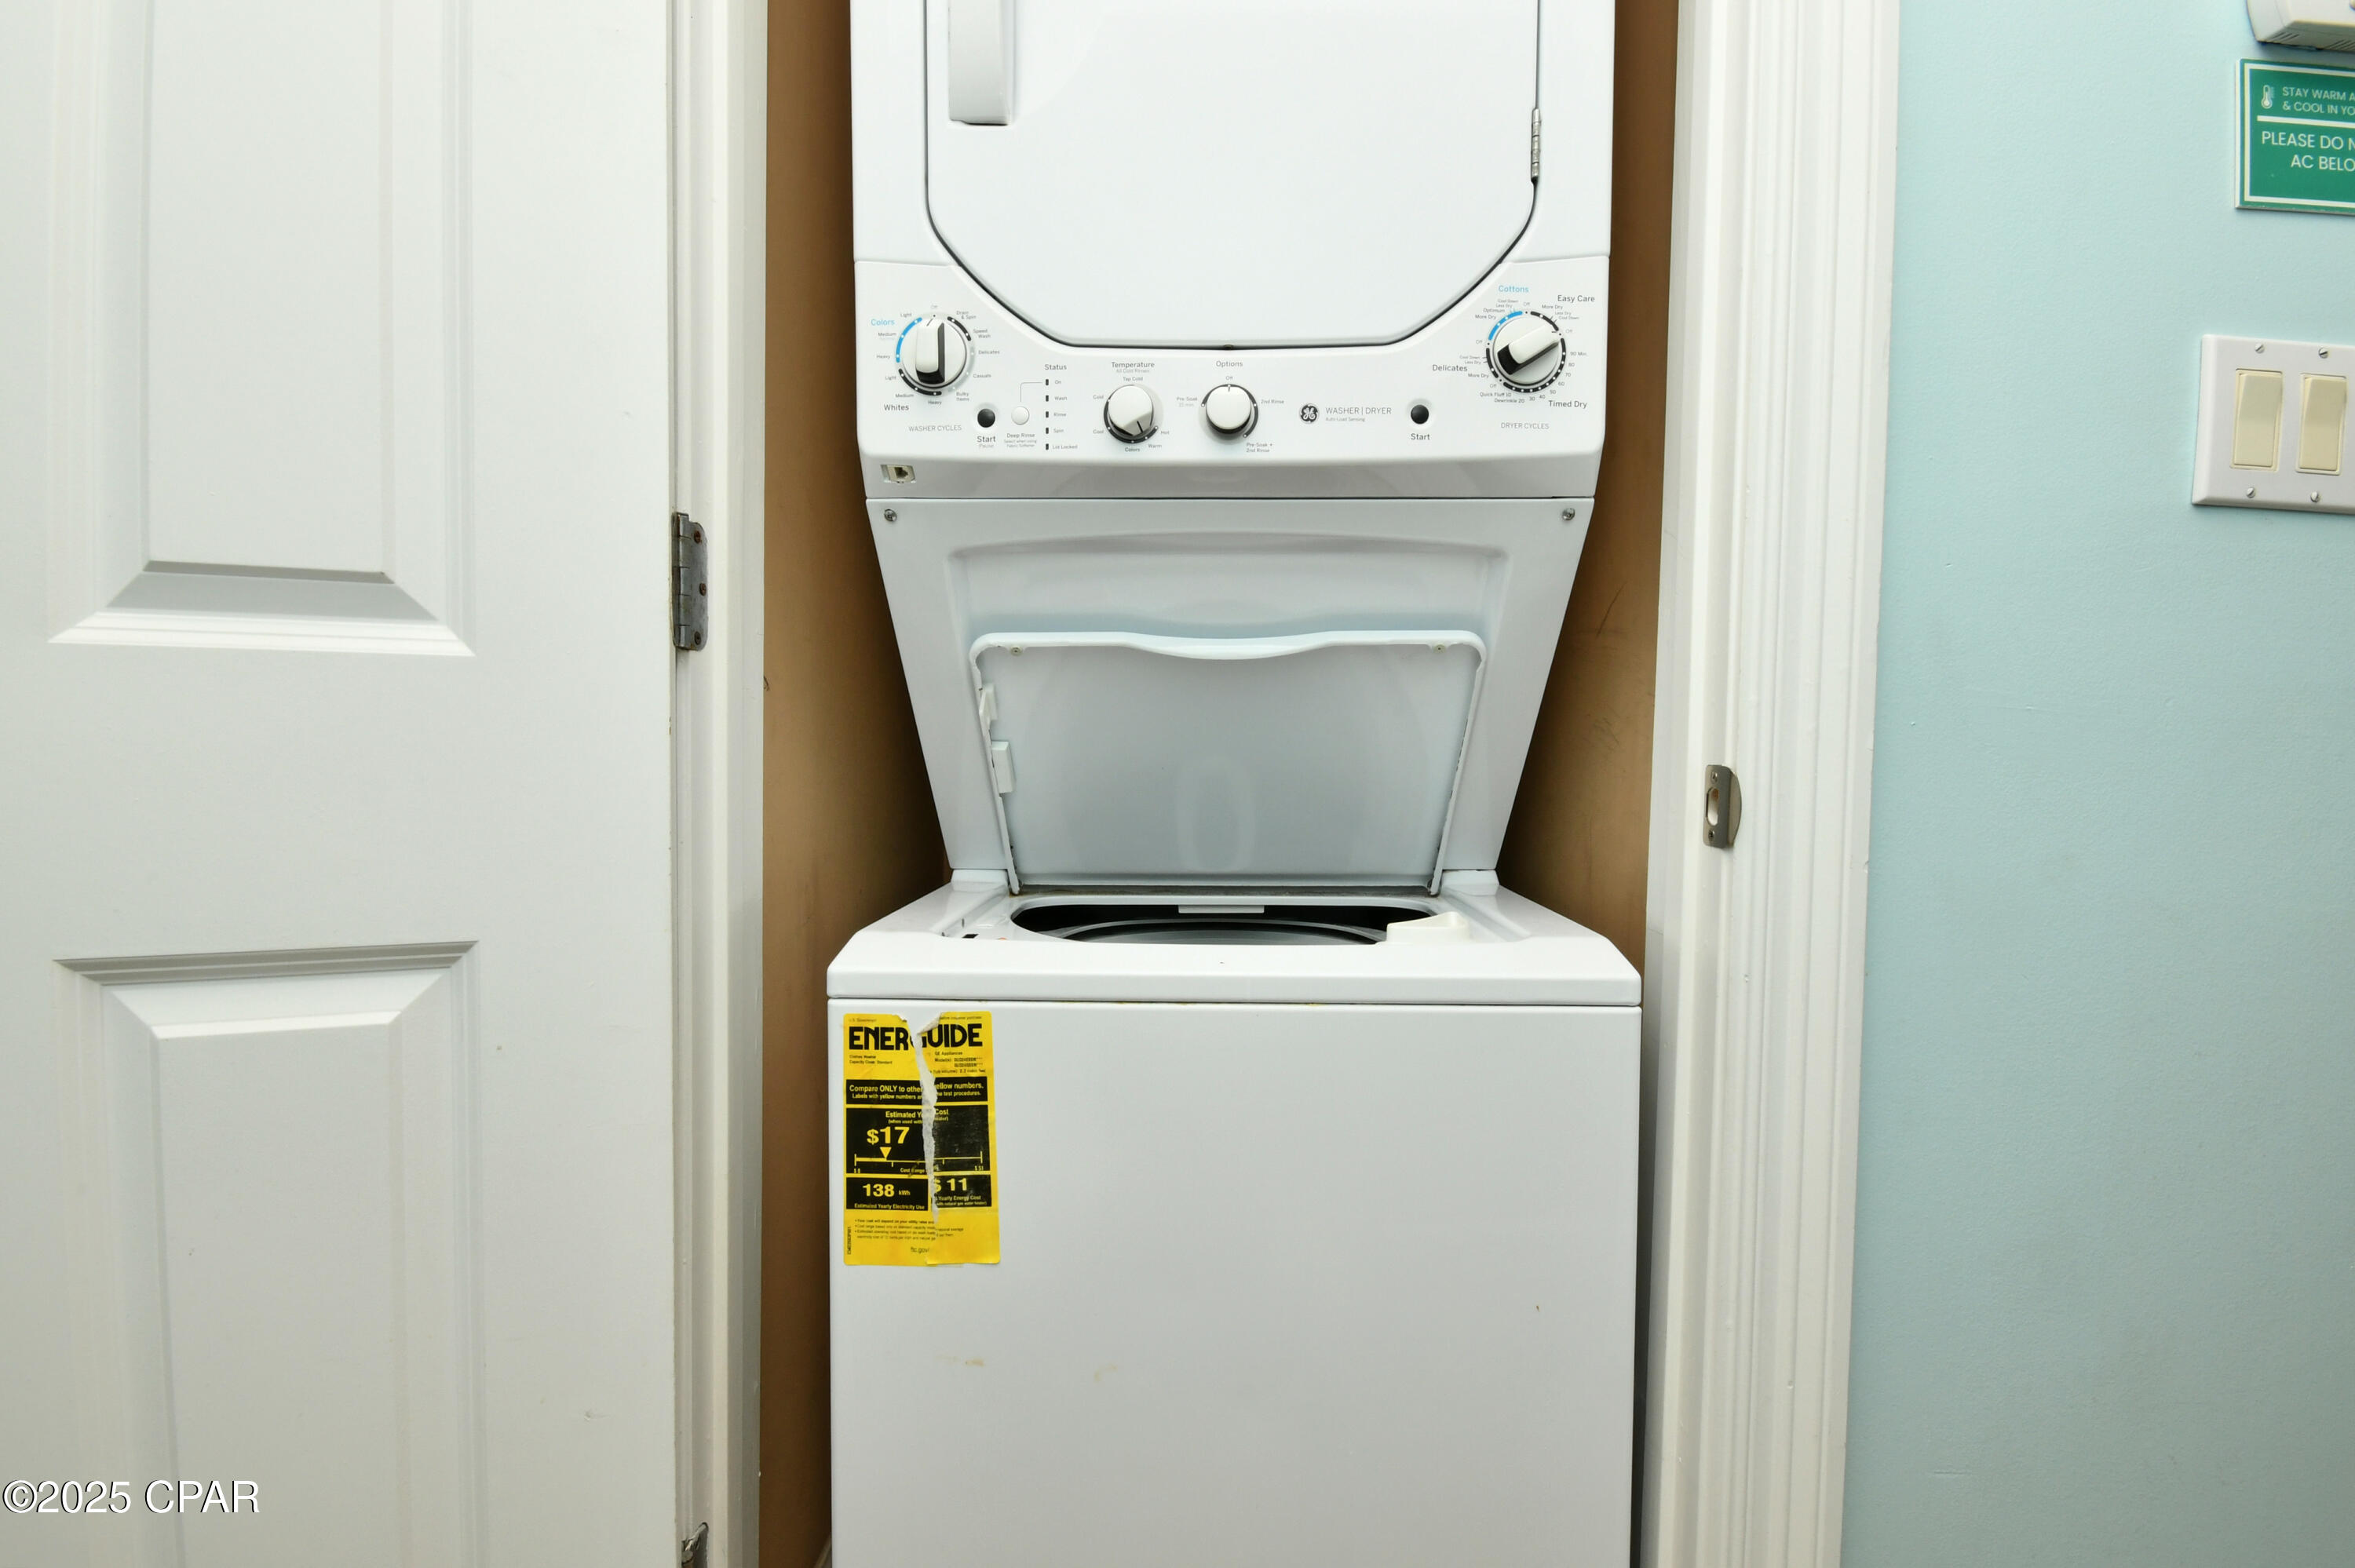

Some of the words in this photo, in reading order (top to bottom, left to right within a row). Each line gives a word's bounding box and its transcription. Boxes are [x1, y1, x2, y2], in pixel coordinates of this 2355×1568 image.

[2283, 87, 2309, 97] STAY
[2313, 89, 2346, 100] WARM
[2283, 100, 2291, 111] &
[2294, 102, 2324, 113] COOL
[2328, 105, 2338, 114] IN
[2262, 131, 2315, 148] PLEASE
[2320, 136, 2343, 150] DO
[2291, 155, 2313, 168] AC
[2319, 156, 2355, 171] BELO
[849, 1026, 914, 1050] ENER
[922, 1023, 982, 1048] UIDE
[849, 1085, 878, 1093] Compare
[867, 1126, 910, 1145] $17
[863, 1184, 894, 1197] 138
[947, 1178, 967, 1191] 11
